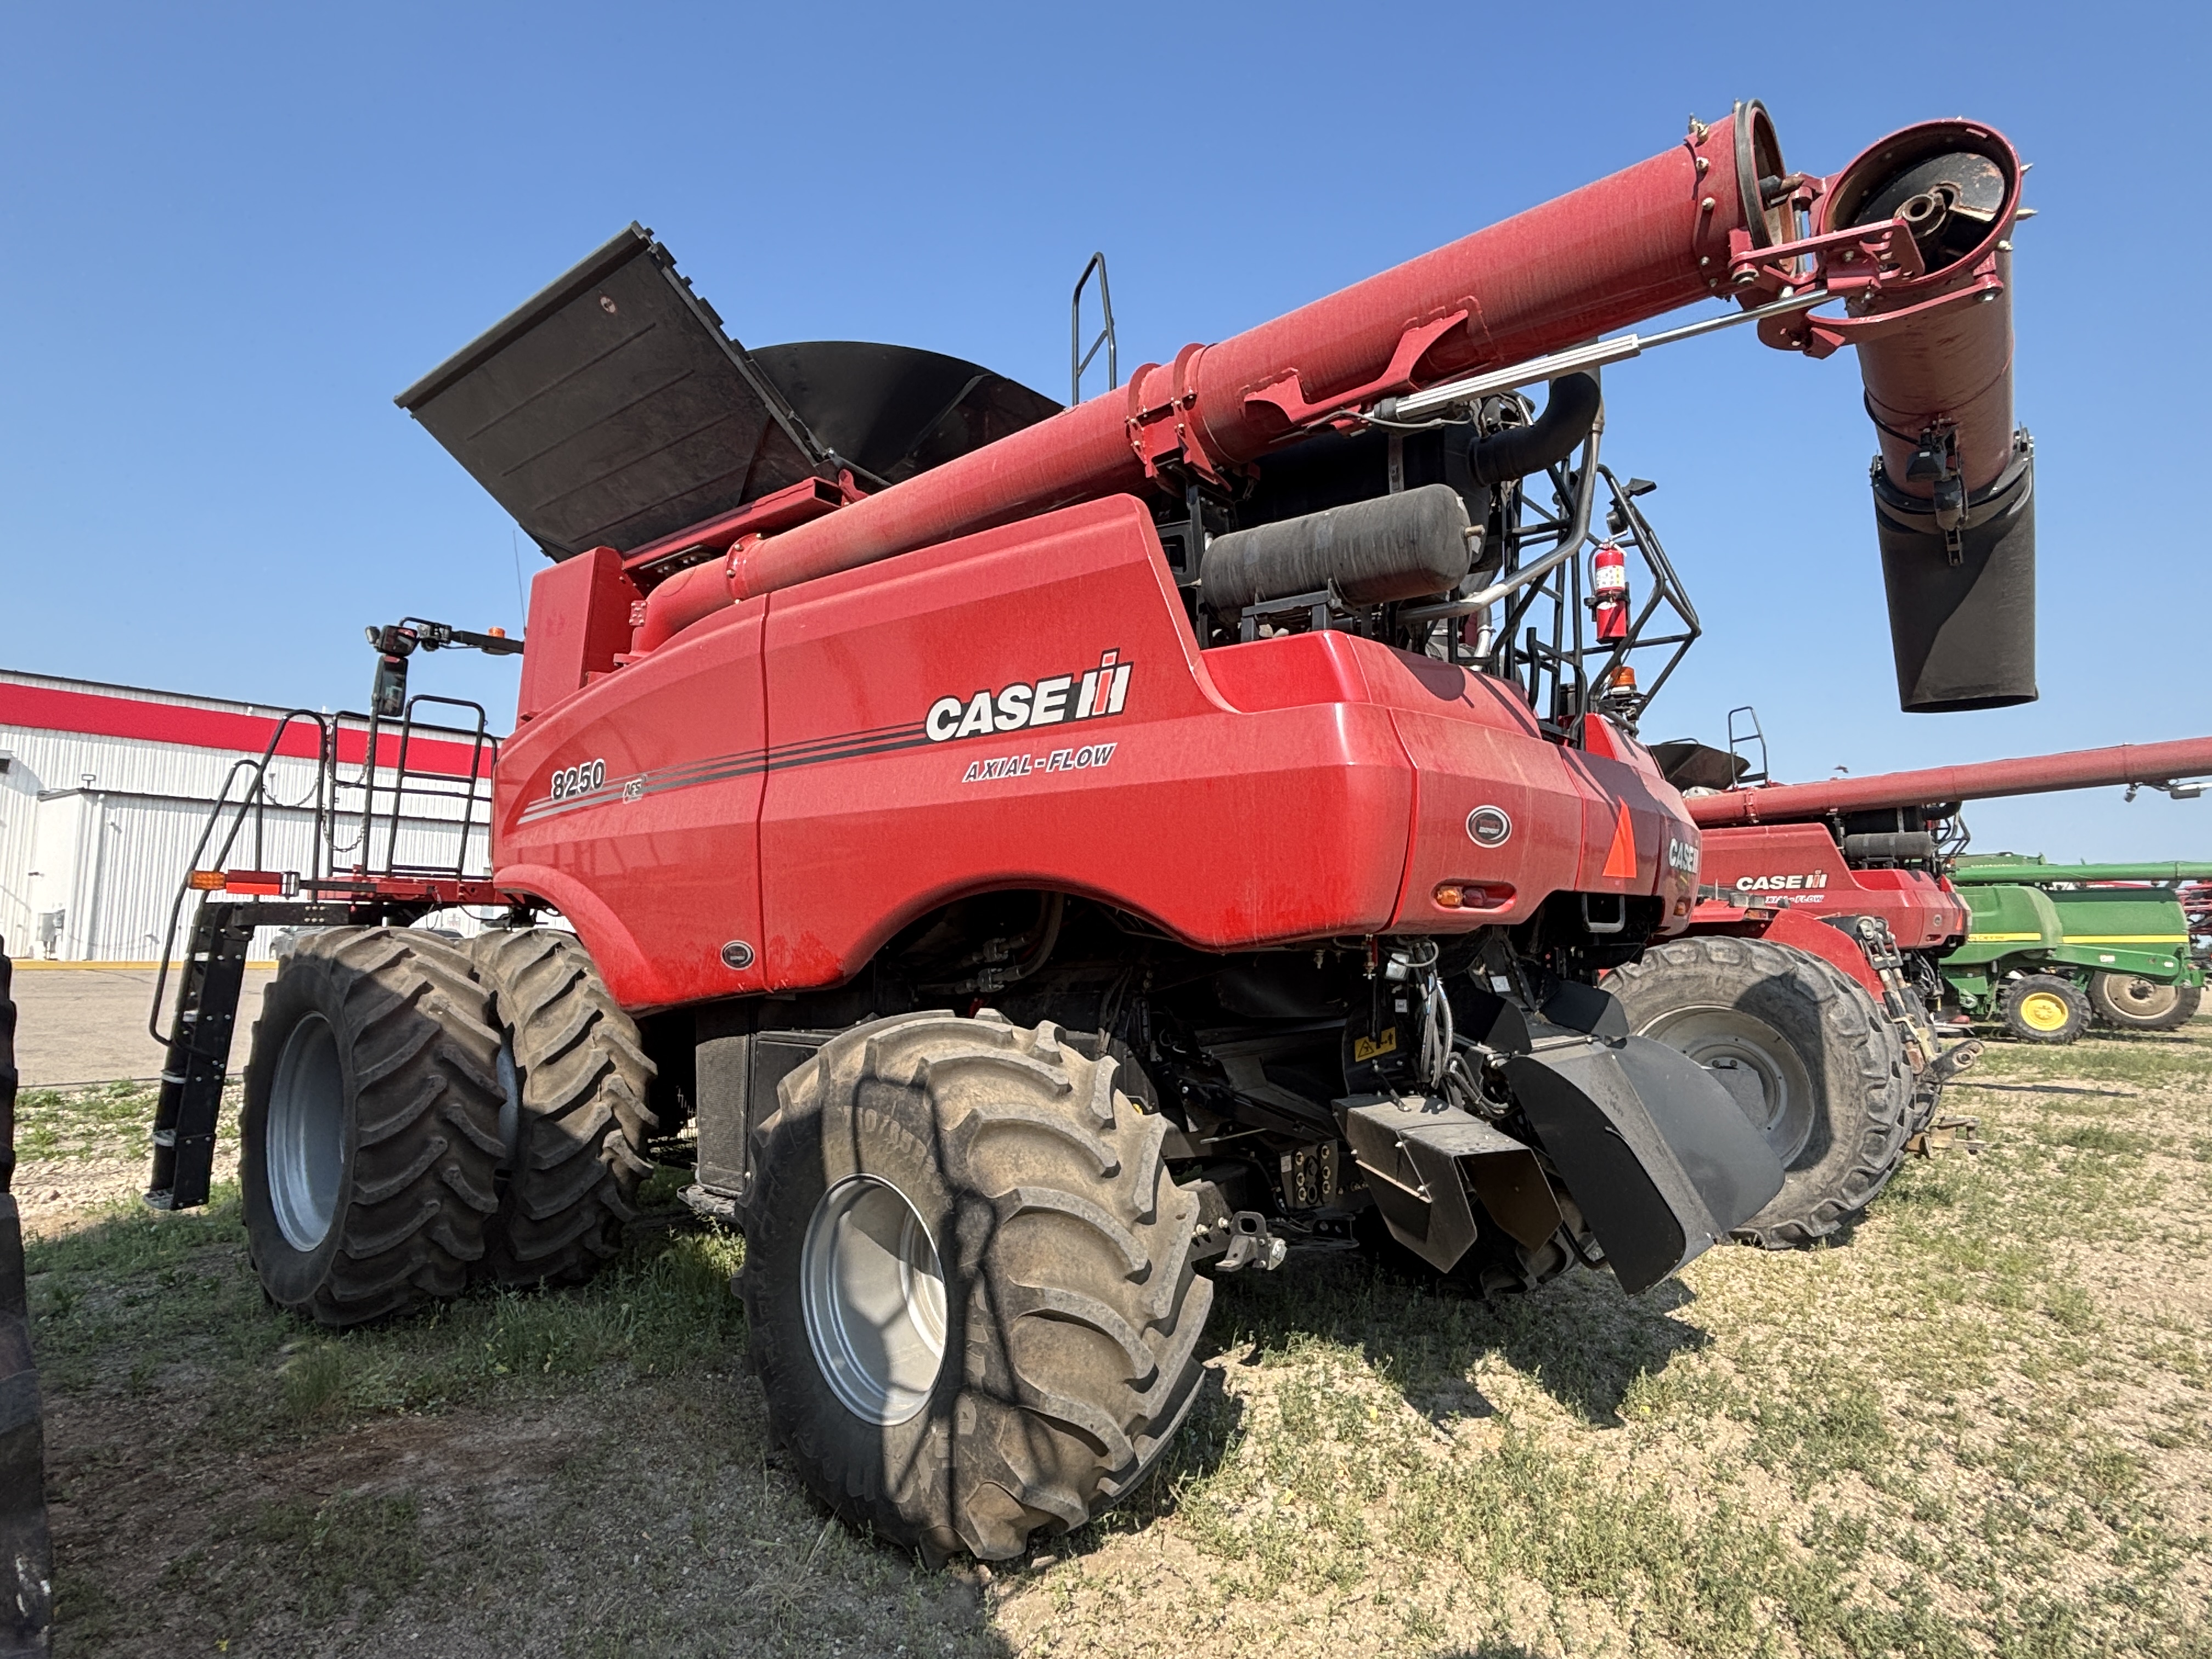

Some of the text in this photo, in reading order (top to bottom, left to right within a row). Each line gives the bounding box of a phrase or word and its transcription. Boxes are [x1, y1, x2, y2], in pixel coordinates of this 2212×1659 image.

[925, 675, 1074, 742] CASE
[551, 758, 605, 800] 8250
[962, 742, 1118, 782] AXIAL-FLOW
[1668, 838, 1694, 872] CASE
[1736, 874, 1803, 891] CASE
